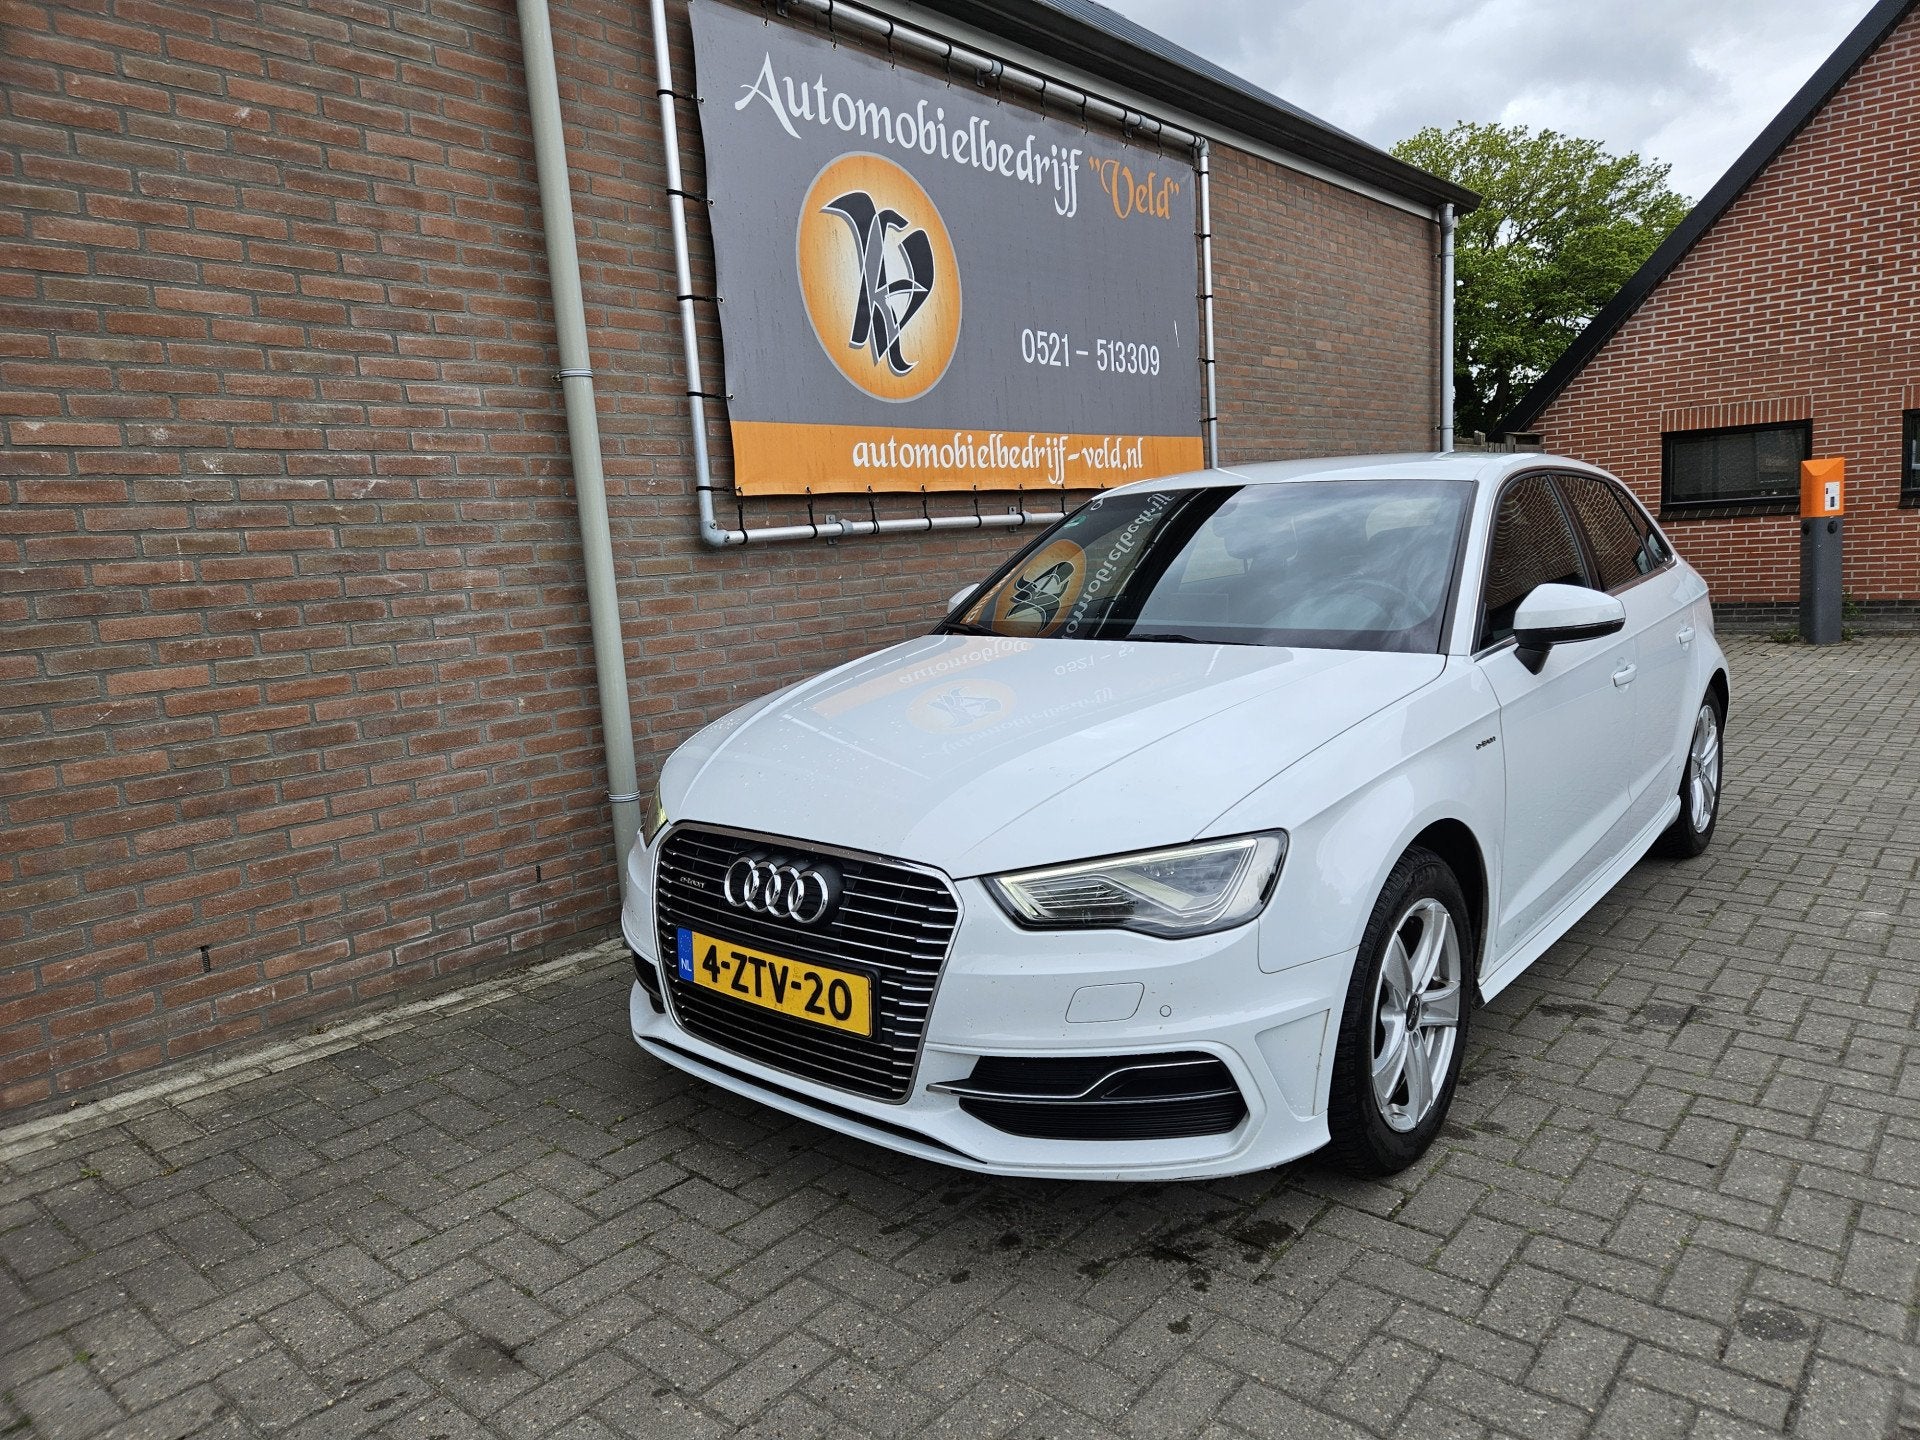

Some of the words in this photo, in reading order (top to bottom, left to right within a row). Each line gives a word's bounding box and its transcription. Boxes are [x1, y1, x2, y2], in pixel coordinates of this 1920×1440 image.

[734, 51, 1082, 218] Automobielbedrijf
[1020, 327, 1070, 367] 0521
[1096, 339, 1160, 376] 513309
[852, 432, 1143, 486] automobielbedrijf-veld.nl
[681, 958, 692, 972] NL
[702, 944, 853, 1021] 4-ZTV-20
